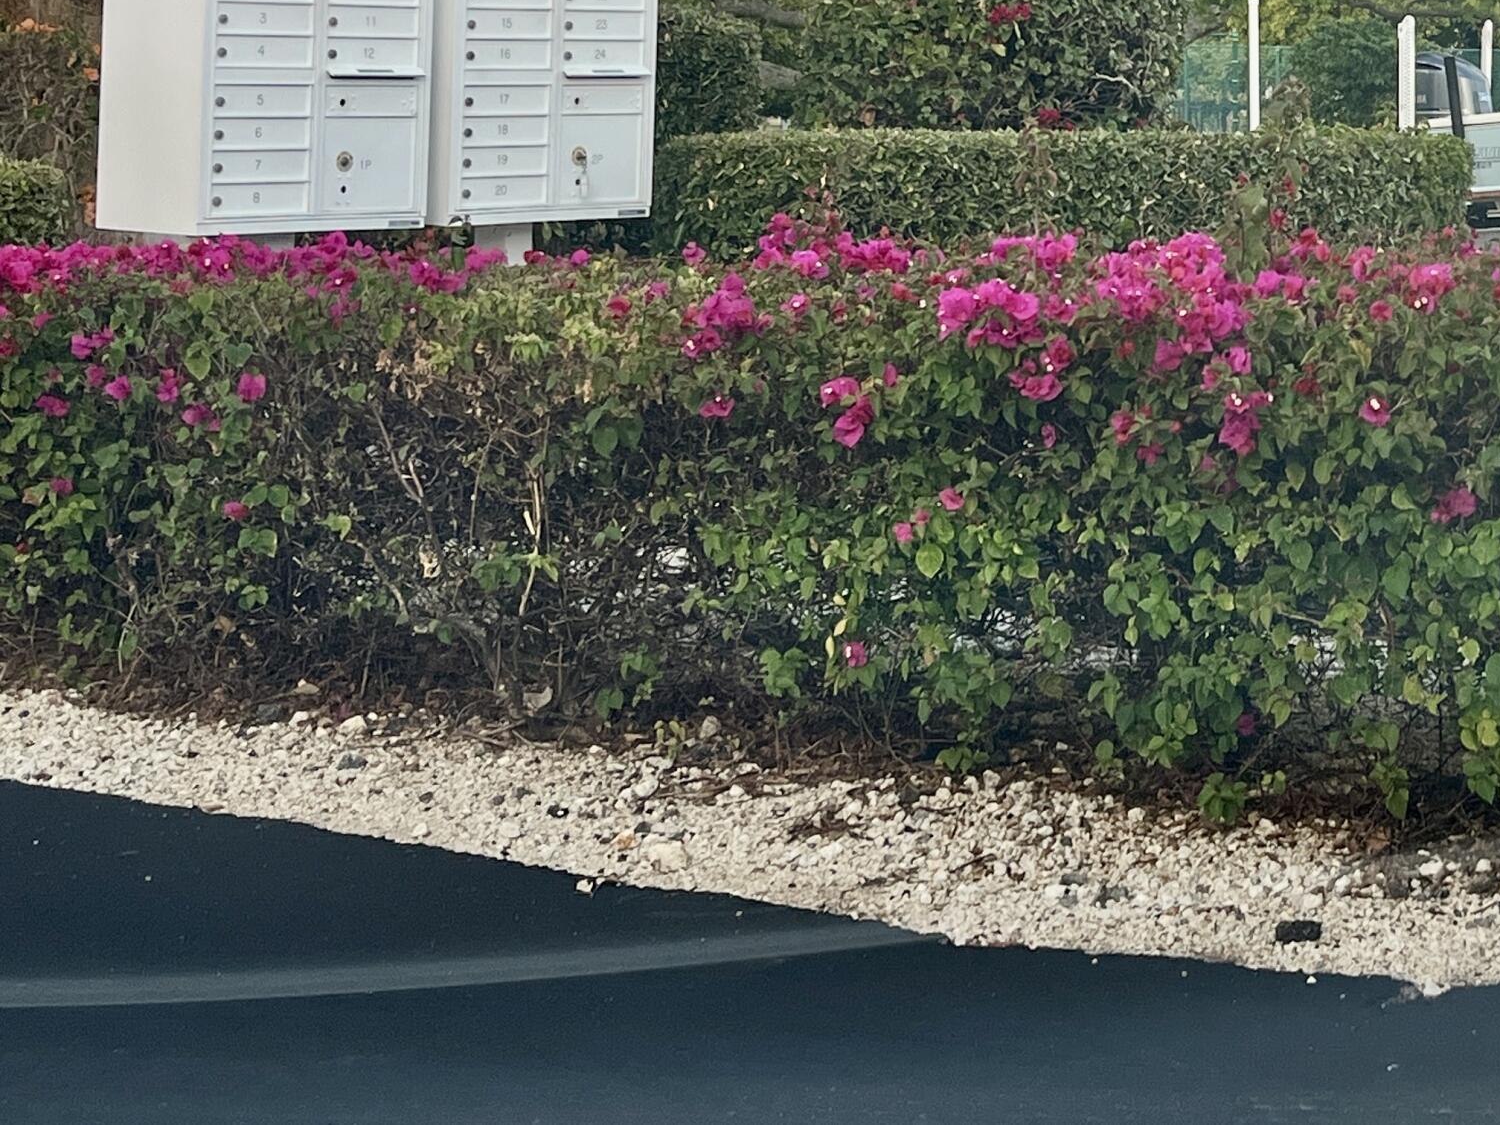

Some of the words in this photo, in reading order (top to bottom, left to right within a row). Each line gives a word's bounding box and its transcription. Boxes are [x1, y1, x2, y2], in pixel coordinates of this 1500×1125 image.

[259, 12, 267, 24] 3
[365, 16, 376, 27] 11
[502, 18, 512, 28] 15
[596, 19, 608, 30] 23
[257, 45, 266, 56] 4
[364, 48, 375, 59] 12
[500, 48, 511, 59] 16
[594, 49, 606, 59] 24
[256, 94, 264, 106] 5
[500, 94, 510, 104] 17
[255, 127, 262, 139] 6
[255, 160, 262, 171] 7
[497, 155, 508, 165] 19
[495, 185, 507, 195] 20
[252, 192, 261, 203] 8
